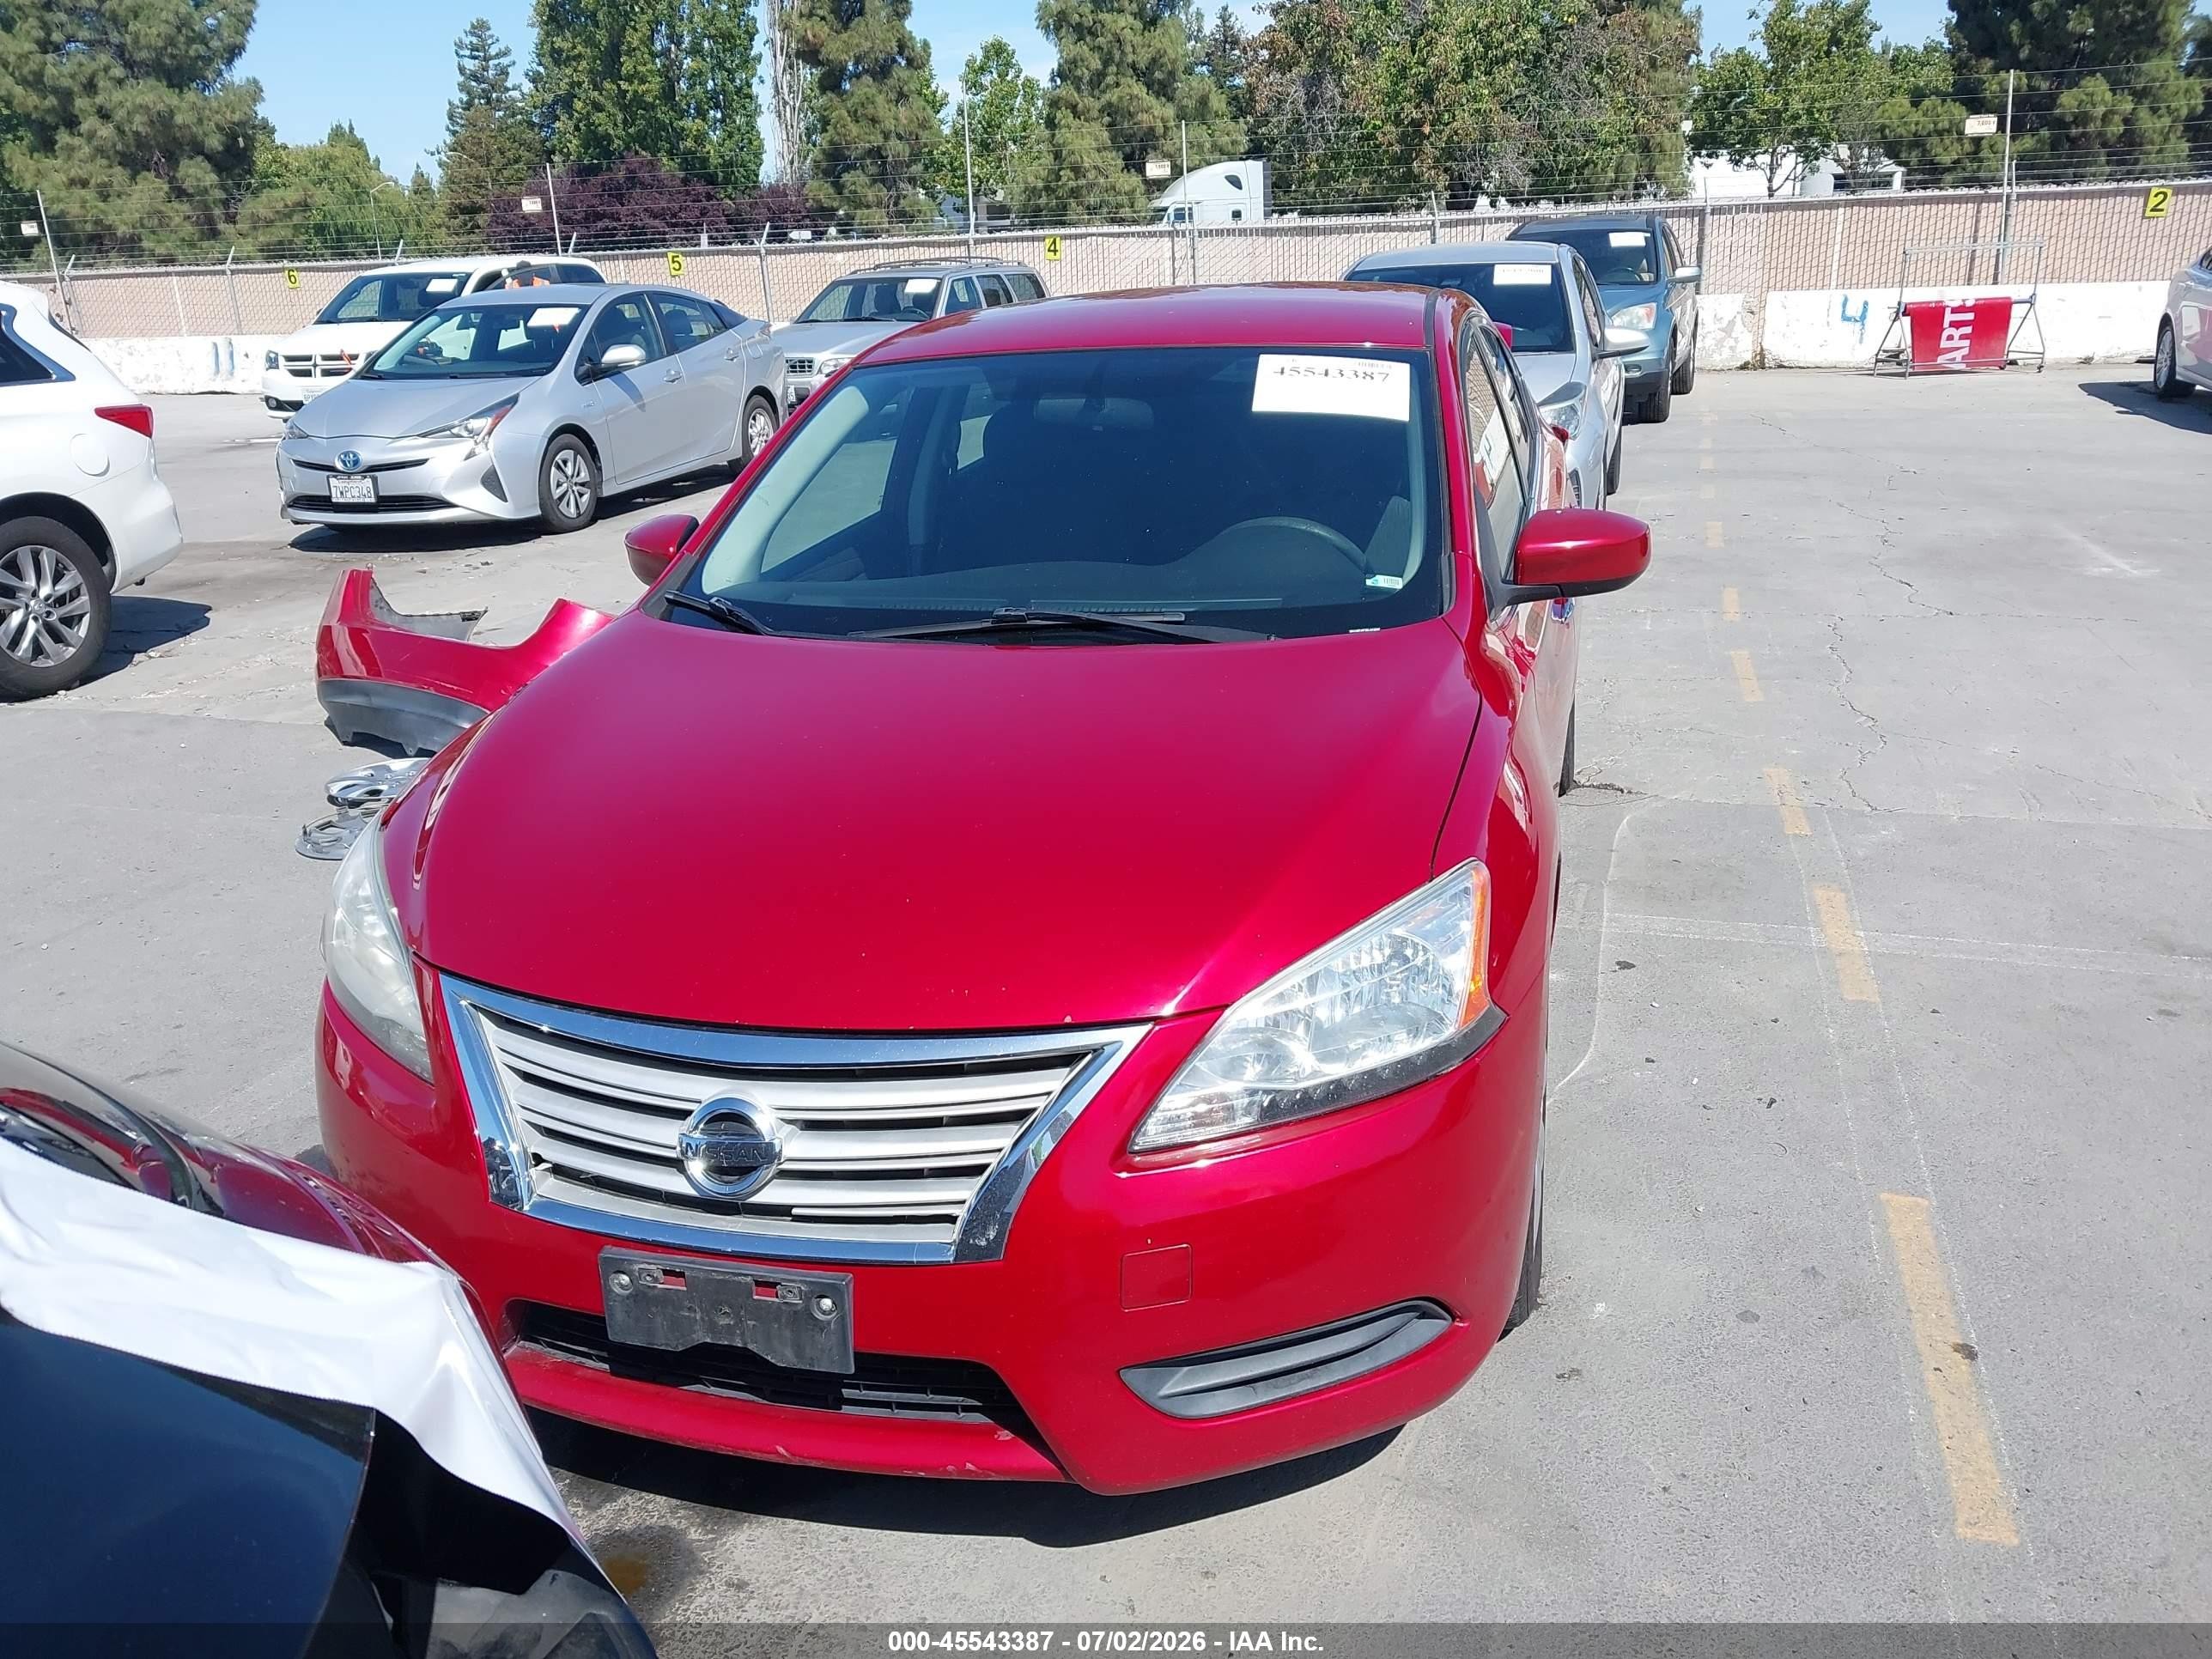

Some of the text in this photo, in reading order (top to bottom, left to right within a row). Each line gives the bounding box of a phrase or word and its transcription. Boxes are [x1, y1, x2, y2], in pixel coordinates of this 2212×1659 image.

[2149, 191, 2168, 212] 2
[1048, 237, 1059, 256] 4
[672, 255, 682, 271] 5
[288, 269, 297, 284] 6
[1841, 294, 1869, 343] 4
[1273, 366, 1389, 382] 45543387
[332, 484, 372, 499] 7WPC348
[685, 1141, 768, 1162] NISSAN
